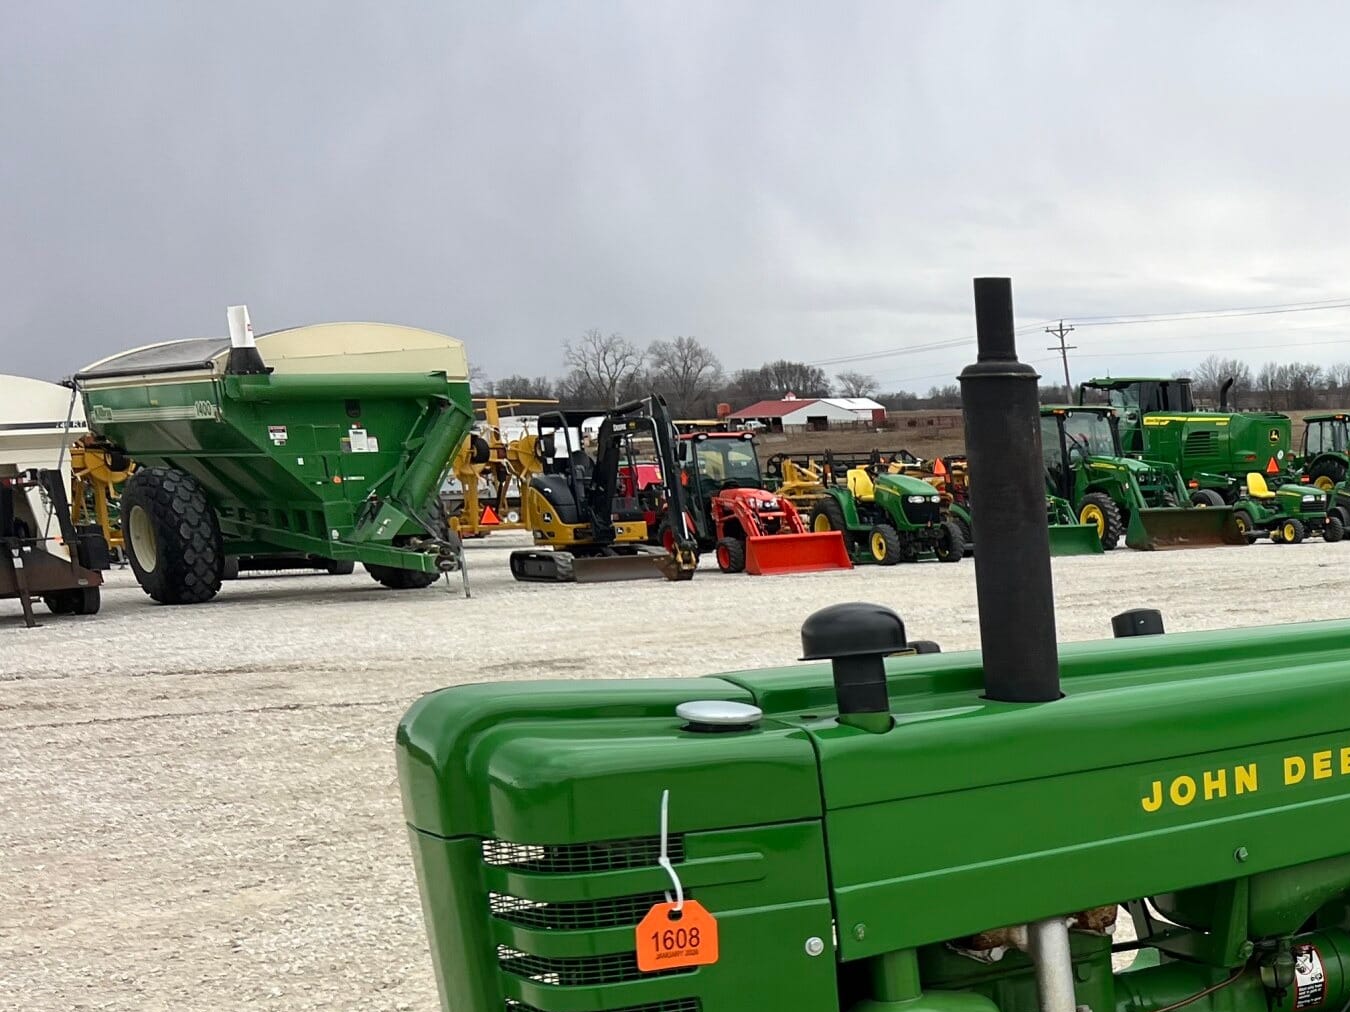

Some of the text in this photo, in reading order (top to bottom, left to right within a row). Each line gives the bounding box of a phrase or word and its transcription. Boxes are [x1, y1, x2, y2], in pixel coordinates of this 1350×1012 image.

[195, 401, 212, 416] 1400
[1141, 763, 1257, 812] JOHN
[651, 927, 700, 952] 1608
